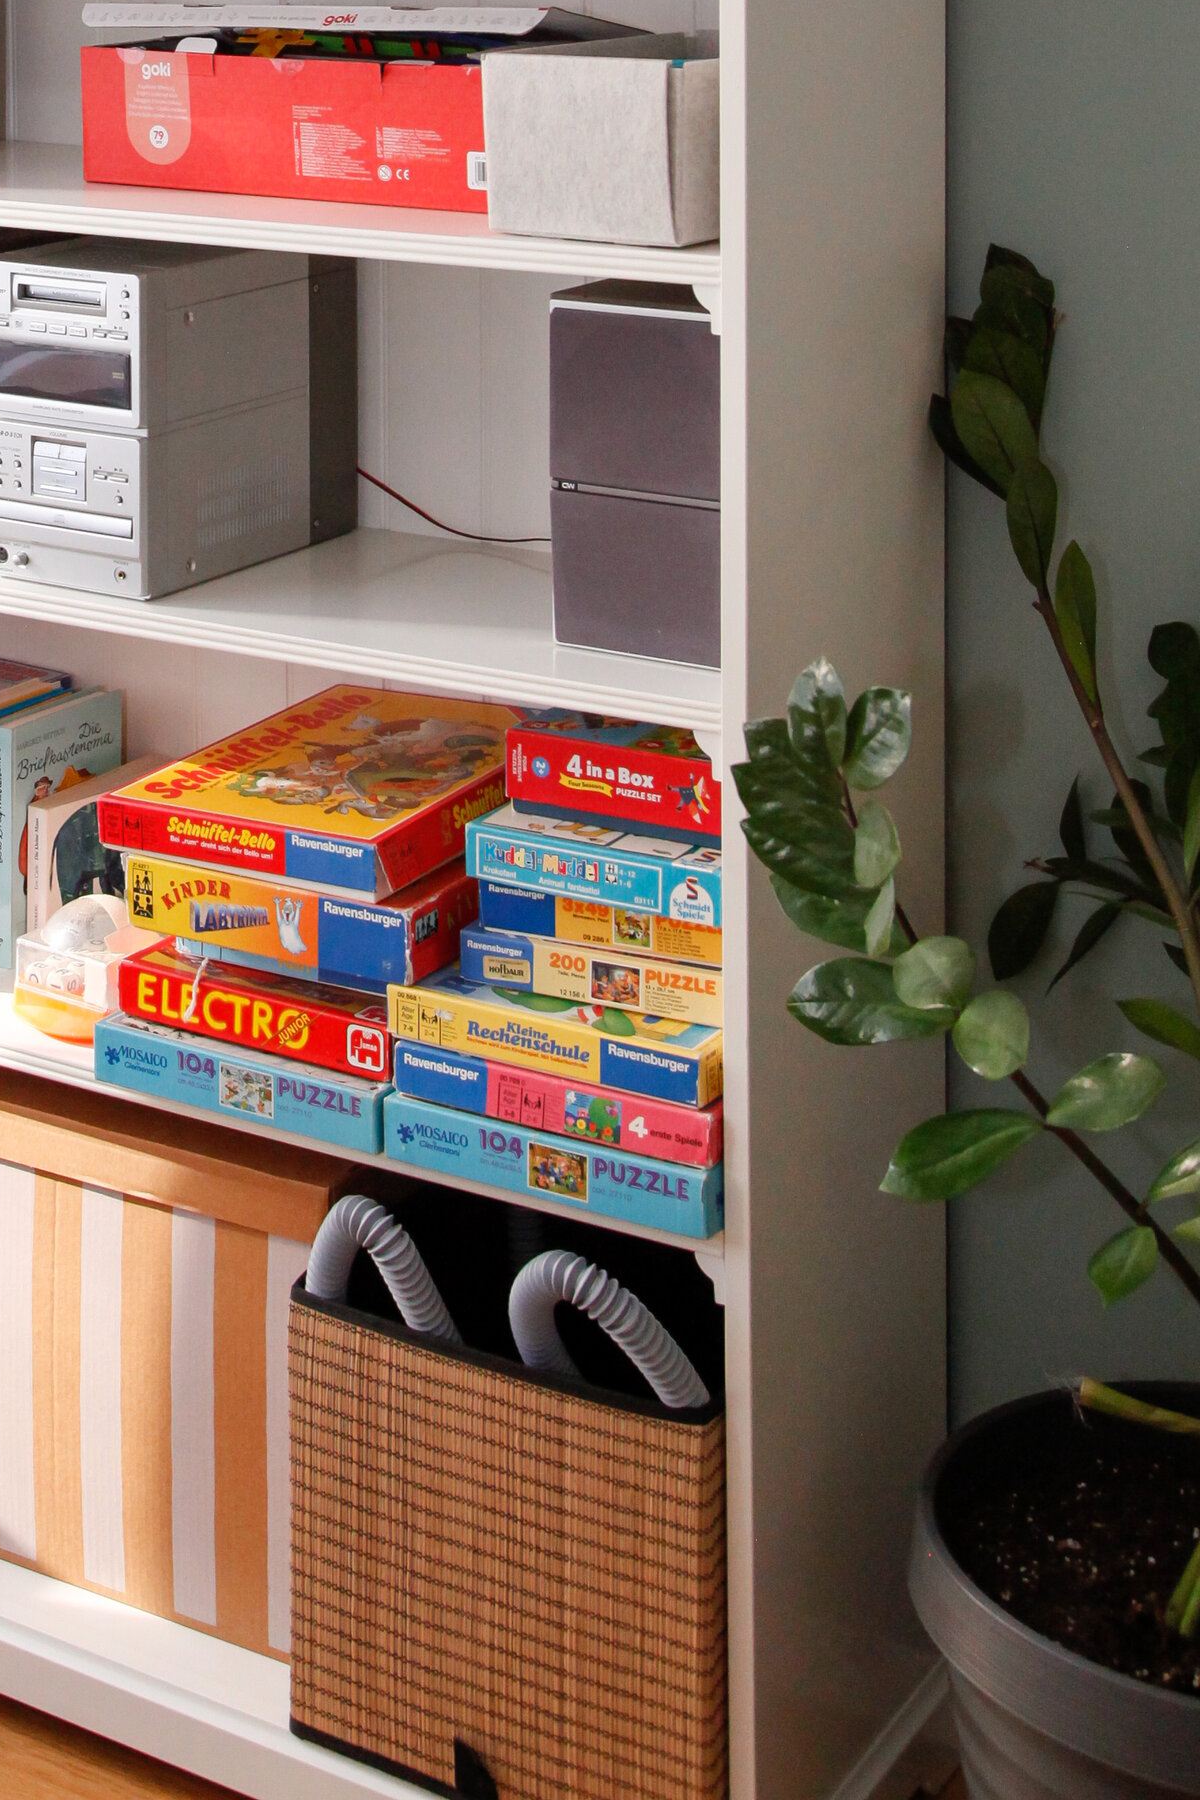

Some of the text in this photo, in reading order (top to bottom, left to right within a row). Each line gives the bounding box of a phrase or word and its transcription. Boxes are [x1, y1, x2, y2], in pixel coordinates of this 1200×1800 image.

[322, 13, 358, 27] goki
[141, 62, 171, 80] goki
[153, 130, 164, 140] 79
[79, 722, 102, 739] Die
[16, 732, 114, 780] Briefkastenoma
[535, 761, 546, 776] 2+
[566, 754, 654, 789] 4 in a Box
[616, 787, 662, 803] PUZZLE SET
[170, 835, 180, 843] Bei
[200, 841, 216, 850] dreht
[218, 843, 231, 852] sich
[232, 846, 242, 854] der
[243, 848, 260, 858] Bello
[291, 834, 364, 858] Ravensburger
[482, 866, 517, 879] Krokofant
[488, 884, 545, 900] Ravensburger
[192, 901, 270, 932] LABYRINTH
[323, 901, 402, 928] Ravensburger
[672, 898, 711, 913] Schmidt
[677, 908, 706, 921] Spiele
[467, 939, 523, 957] Ravensburger
[550, 952, 585, 972] 200
[569, 990, 581, 998] 156
[645, 969, 717, 996] PUZZLE
[138, 972, 309, 1050] ELECTRO
[278, 1012, 311, 1046] JUNIOR
[467, 1020, 590, 1062] Rechenschule
[506, 1021, 548, 1041] Kleine
[118, 1045, 168, 1069] MOSAICO
[177, 1050, 217, 1079] 104
[403, 1053, 479, 1081] Ravensburger
[608, 1043, 690, 1073] Ravensburger
[124, 1063, 161, 1077] Clementoni
[277, 1076, 362, 1118] PUZZLE
[412, 1123, 469, 1147] MOSAICO
[478, 1128, 524, 1159] 104
[628, 1115, 703, 1148] 4 erste Spiele
[418, 1139, 461, 1157] Clementoni
[592, 1157, 690, 1201] PUZZLE
